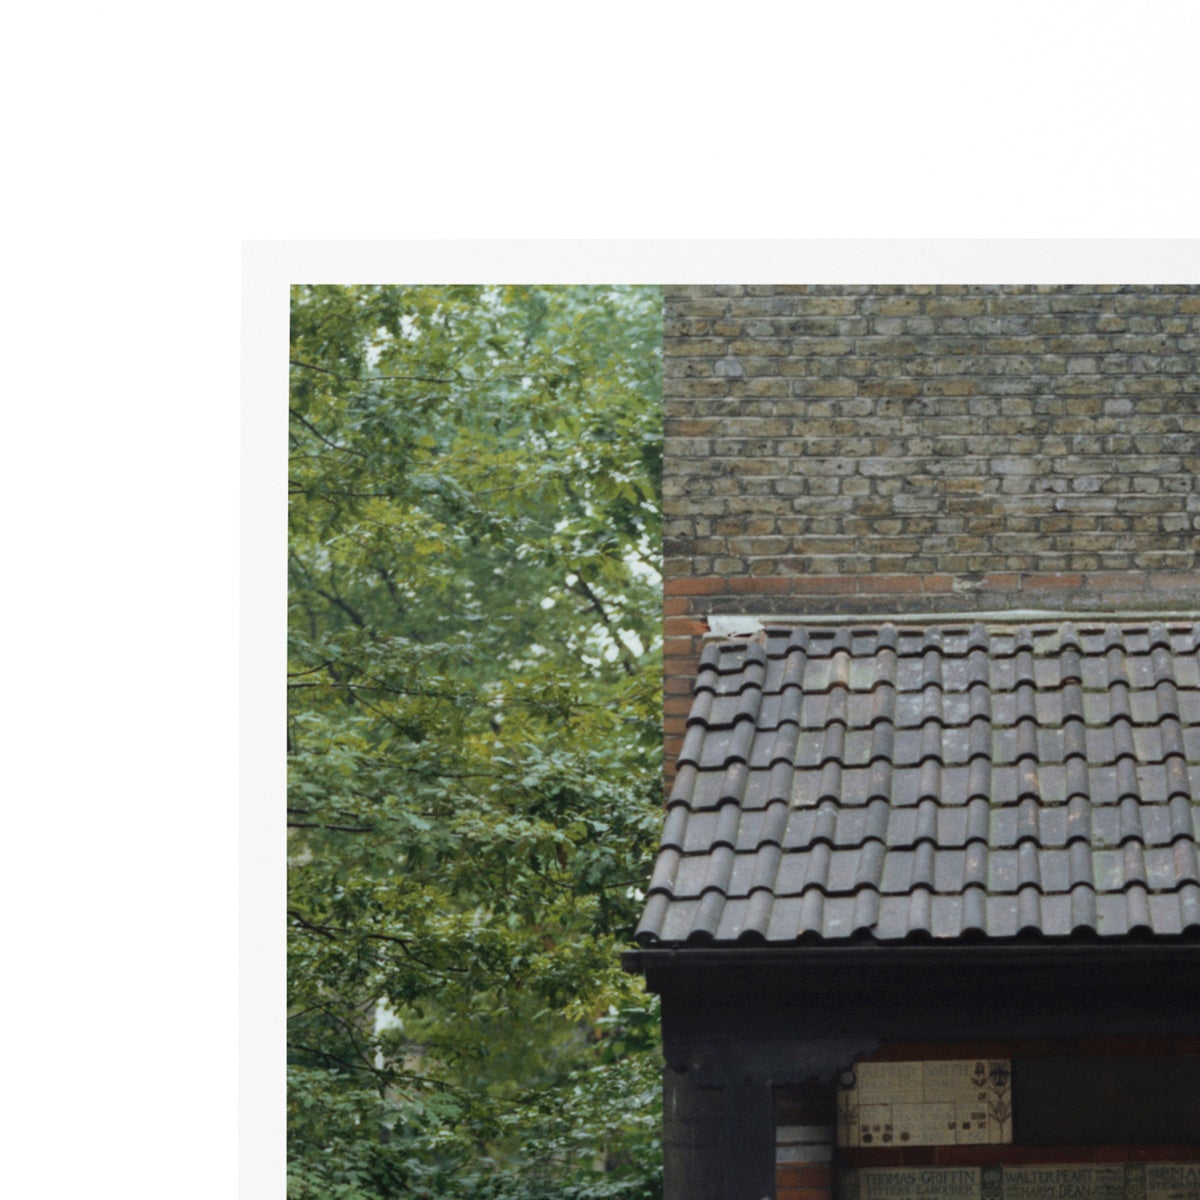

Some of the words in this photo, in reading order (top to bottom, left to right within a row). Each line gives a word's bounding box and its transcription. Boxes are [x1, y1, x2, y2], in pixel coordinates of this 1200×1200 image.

[863, 1065, 918, 1079] ALFRED
[925, 1062, 971, 1077] SMITH
[865, 1173, 916, 1185] THOMAS
[921, 1170, 976, 1184] GRIFFIN
[1004, 1171, 1055, 1184] WALTER
[1056, 1169, 1091, 1182] PEART
[917, 1185, 973, 1195] LABOURER
[1020, 1186, 1054, 1198] HARRY
[1058, 1184, 1089, 1198] DEAN
